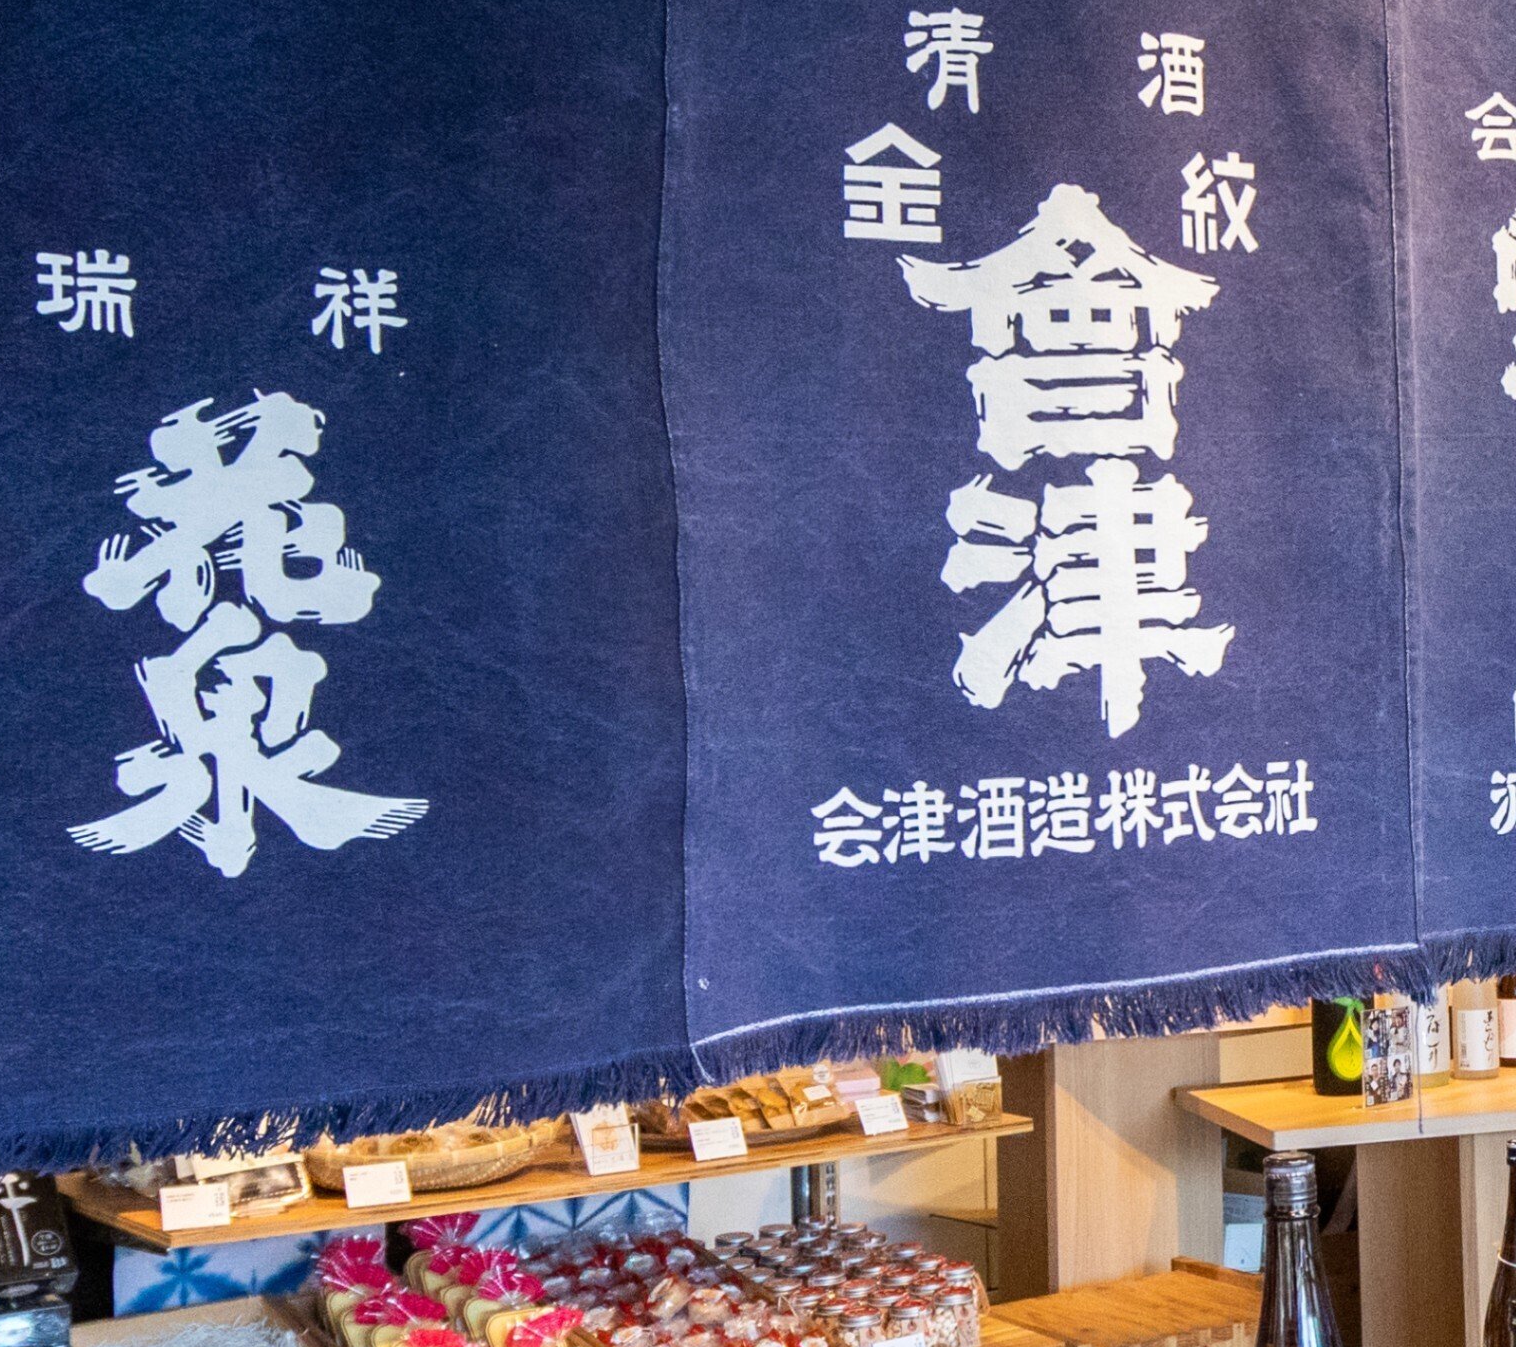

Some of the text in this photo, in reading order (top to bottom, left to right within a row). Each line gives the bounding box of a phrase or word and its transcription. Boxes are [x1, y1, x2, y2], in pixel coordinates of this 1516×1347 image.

[904, 7, 1205, 116] 清 酒
[843, 121, 1257, 254] 金 紋
[895, 181, 1237, 738] 會津
[809, 758, 1318, 868] 会津酒造株式会社
